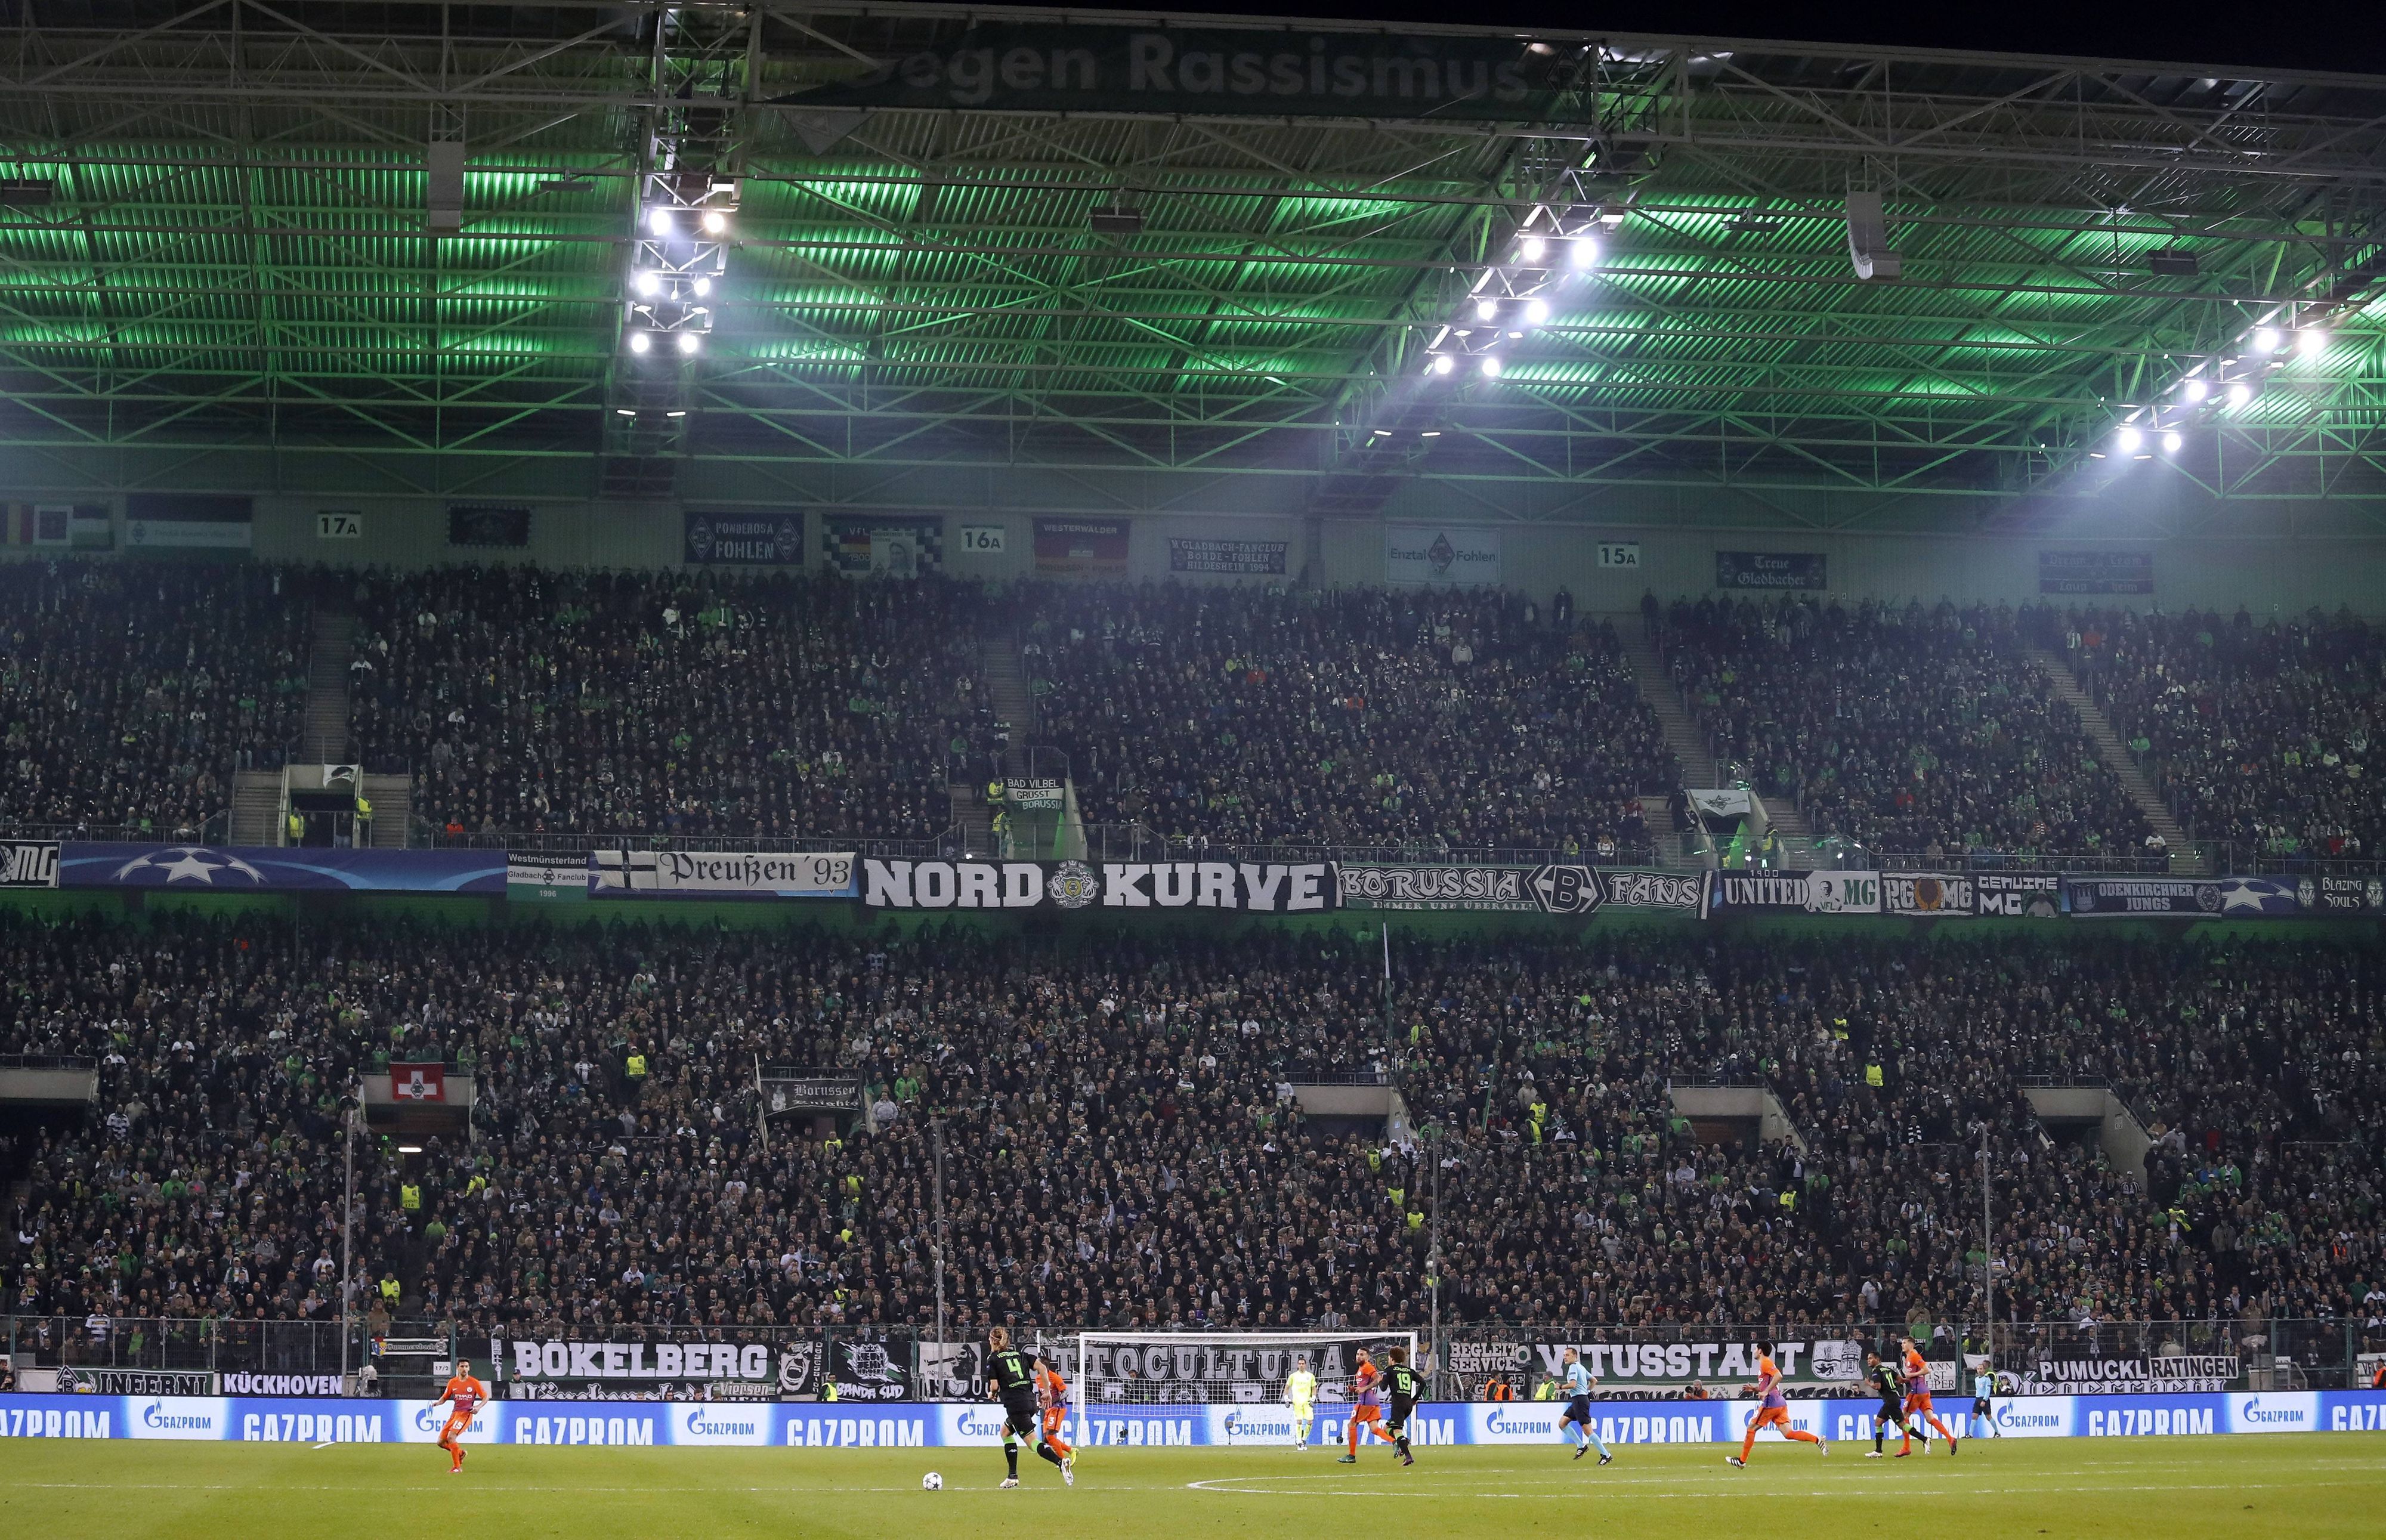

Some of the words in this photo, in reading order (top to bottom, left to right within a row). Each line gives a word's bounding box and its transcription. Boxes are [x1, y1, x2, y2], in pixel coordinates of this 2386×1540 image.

[1130, 33, 1528, 103] Rassismus
[321, 517, 357, 535] 17A
[716, 522, 774, 534] PONDEROSA
[965, 532, 1000, 549] 16A
[715, 542, 774, 559] FOHLEN
[1390, 548, 1426, 561] Enztal
[1456, 550, 1495, 562] Fohlen
[1601, 548, 1636, 564] 15A
[1187, 561, 1245, 571] HILDESHEIM
[1754, 556, 1789, 569] Treue
[1737, 572, 1806, 587] Gladbacher
[1007, 778, 1025, 788] BAD
[1029, 779, 1059, 788] VILBEL
[1022, 800, 1062, 810] BORUSSIA
[508, 853, 587, 865] Westmünsterland
[508, 871, 541, 880] Gladbach
[659, 852, 796, 886] Preußen
[864, 858, 1043, 908] NORD
[1104, 862, 1325, 911] KURVE
[1340, 868, 1520, 902] BORUSSIA
[1609, 873, 1700, 907] FANS
[1724, 877, 1810, 905] UNITED
[1843, 879, 1875, 905] MG
[2098, 883, 2195, 897] ODENKIRCHNER
[1940, 880, 1973, 908] MG
[1372, 901, 1422, 910] IMMER
[1979, 892, 2023, 916] MG
[2127, 897, 2171, 911] JUNGS
[794, 1084, 855, 1096] Borussen
[1449, 1342, 1518, 1357] BEGLEIT
[513, 1338, 768, 1378] BÖKELBERG
[1448, 1357, 1515, 1372] SERVICE
[1006, 1358, 1024, 1380] 4
[2040, 1359, 2148, 1381] PUMUCKL
[2152, 1357, 2237, 1378] RATINGEN
[99, 1372, 207, 1395] INFERNI
[224, 1371, 342, 1395] KÜCKHOVEN
[719, 1381, 768, 1395] Viersen
[1397, 1373, 1411, 1391] 19
[1926, 1380, 1955, 1389] UPER
[836, 1383, 876, 1399] BANDA
[879, 1384, 904, 1399] SUD
[163, 1417, 211, 1429] GAZPROM
[1047, 1416, 1055, 1425] 3
[2015, 1415, 2059, 1427] GAZPROM
[2089, 1408, 2214, 1436] GAZPROM
[2261, 1410, 2304, 1423] GAZPROM
[243, 1414, 381, 1442] GAZPROM
[452, 1420, 463, 1429] 15
[516, 1417, 653, 1446] GAZPROM
[707, 1423, 754, 1435] GAZPROM
[1244, 1423, 1290, 1436] GAZPROM
[1506, 1421, 1551, 1434] GAZPROM
[787, 1419, 923, 1447] GAZPROM
